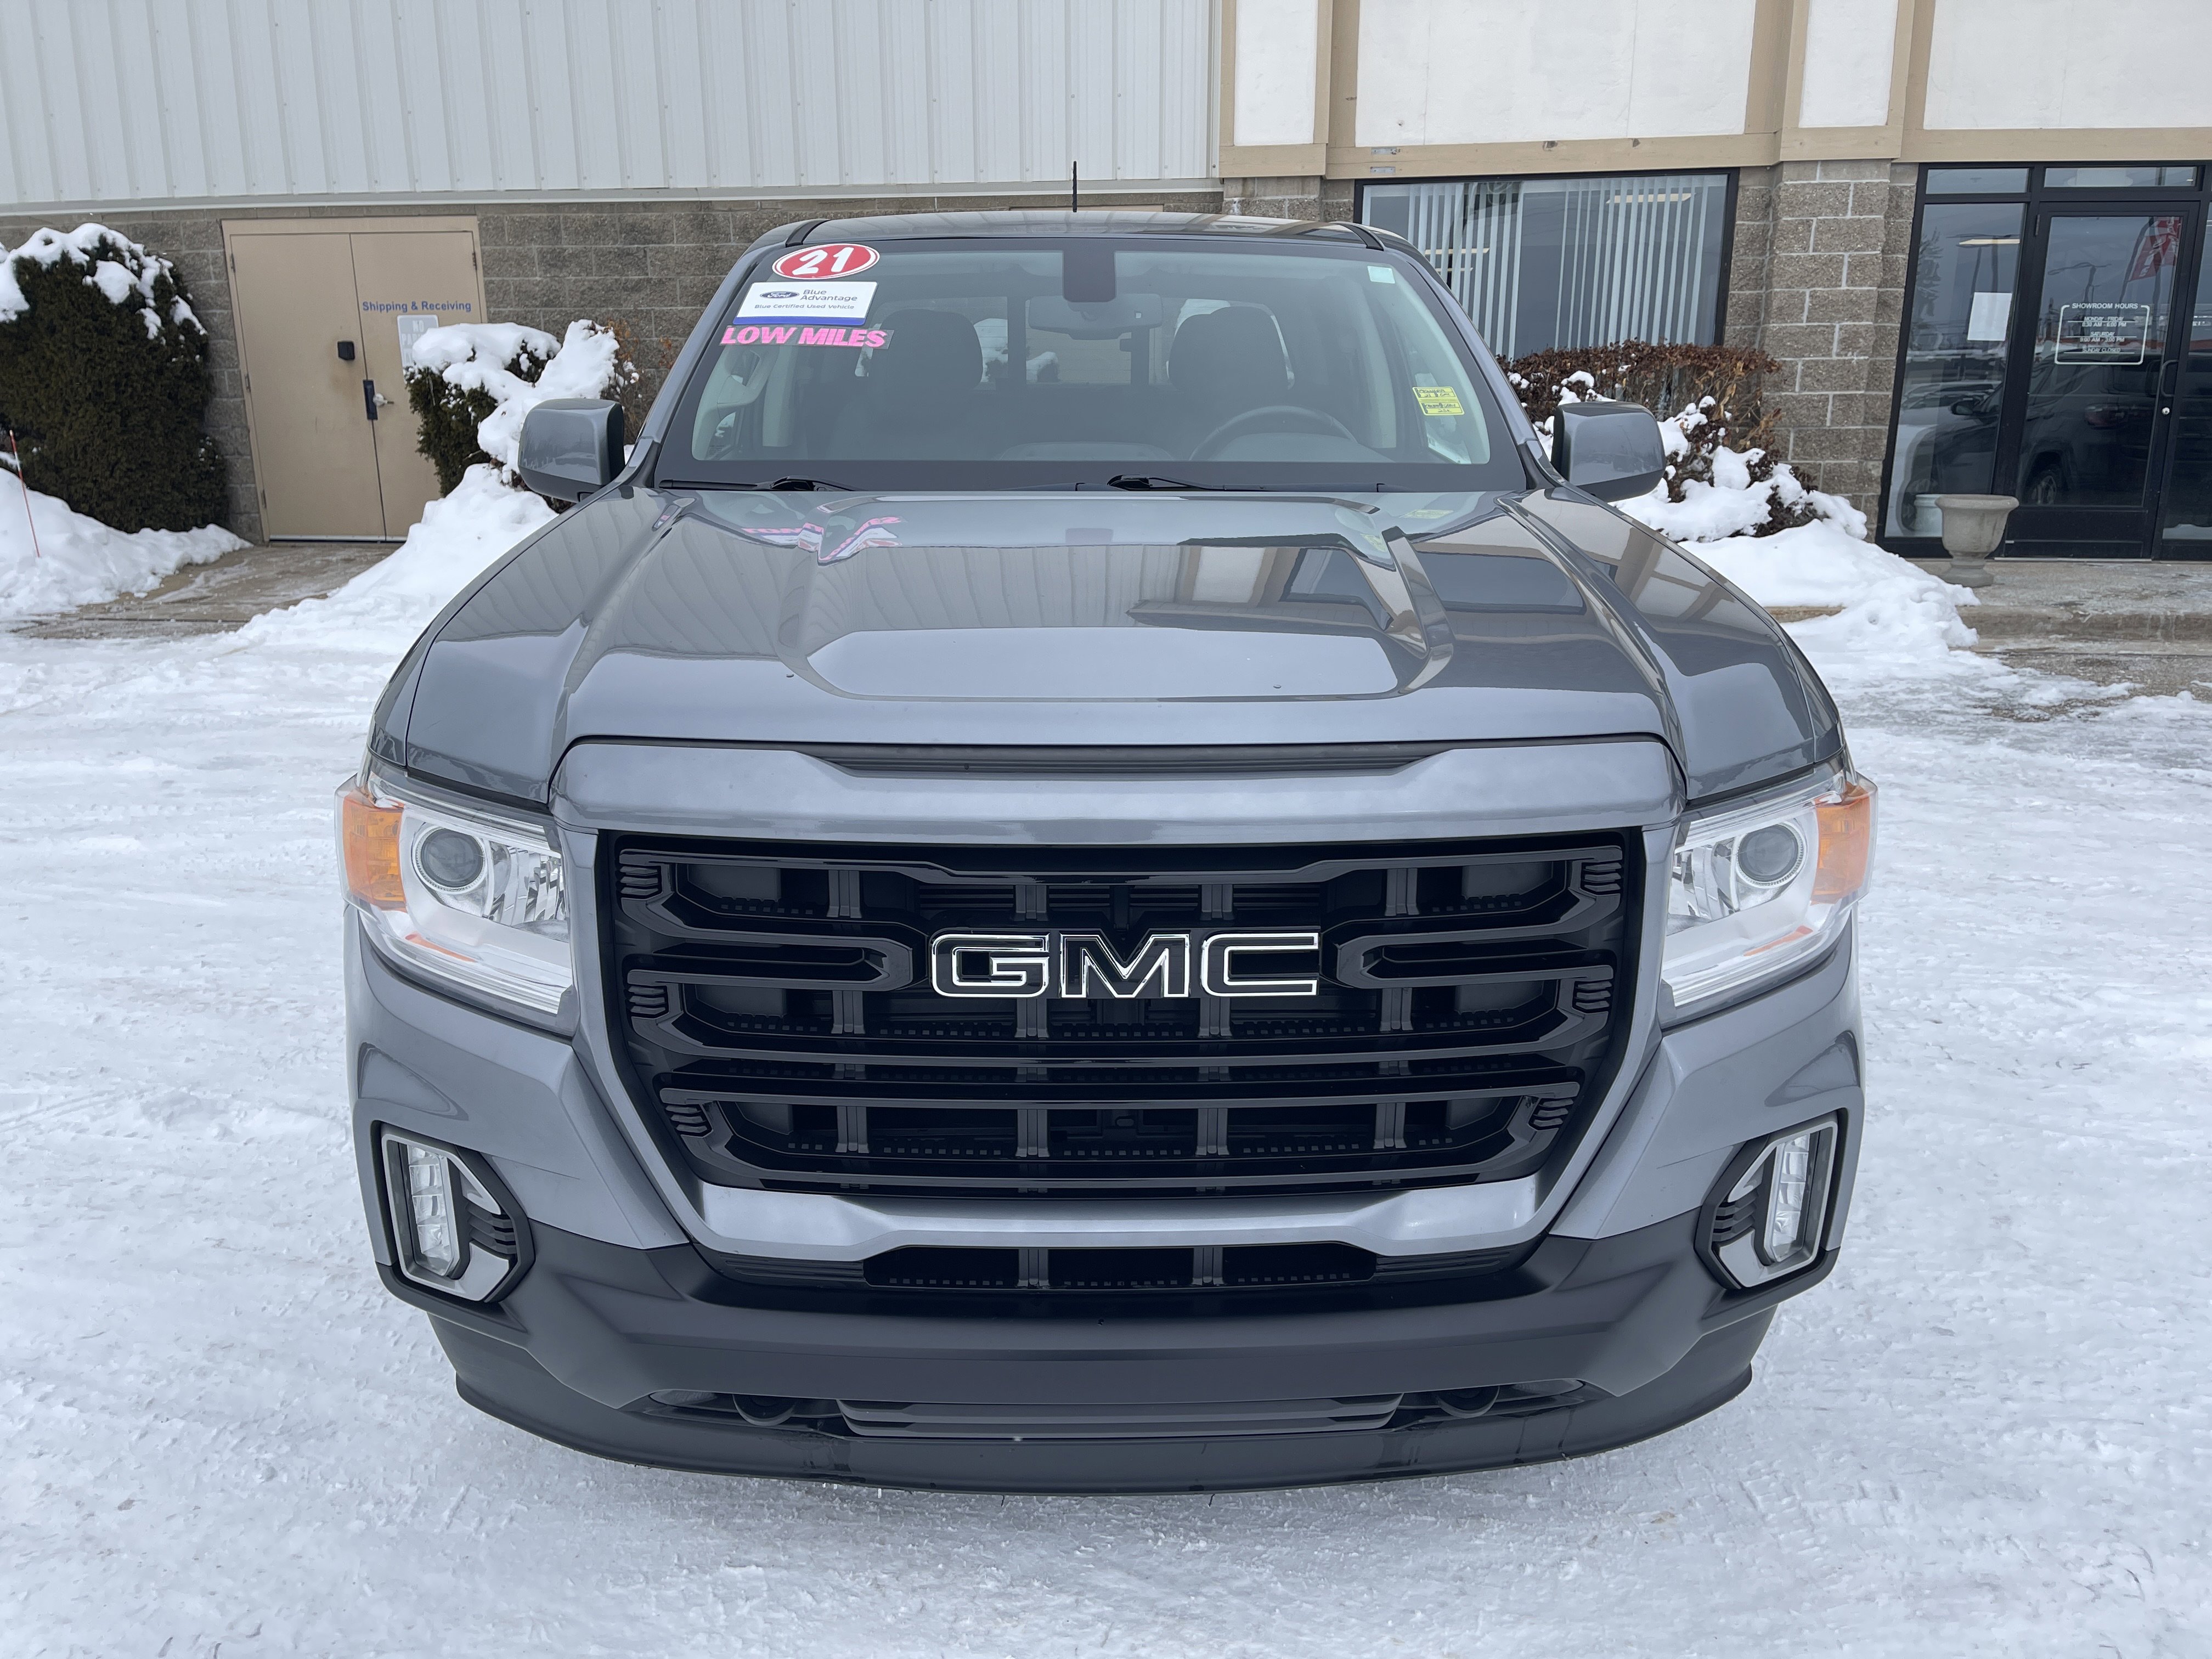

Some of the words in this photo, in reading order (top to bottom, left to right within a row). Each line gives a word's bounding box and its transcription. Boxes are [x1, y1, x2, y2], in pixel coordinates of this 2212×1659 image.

[792, 247, 854, 275] 21
[363, 301, 408, 313] Shipping
[411, 301, 418, 311] &
[421, 301, 471, 313] Receiving
[720, 325, 797, 345] LOW
[798, 327, 888, 348] MILES
[931, 932, 1319, 997] GMC
